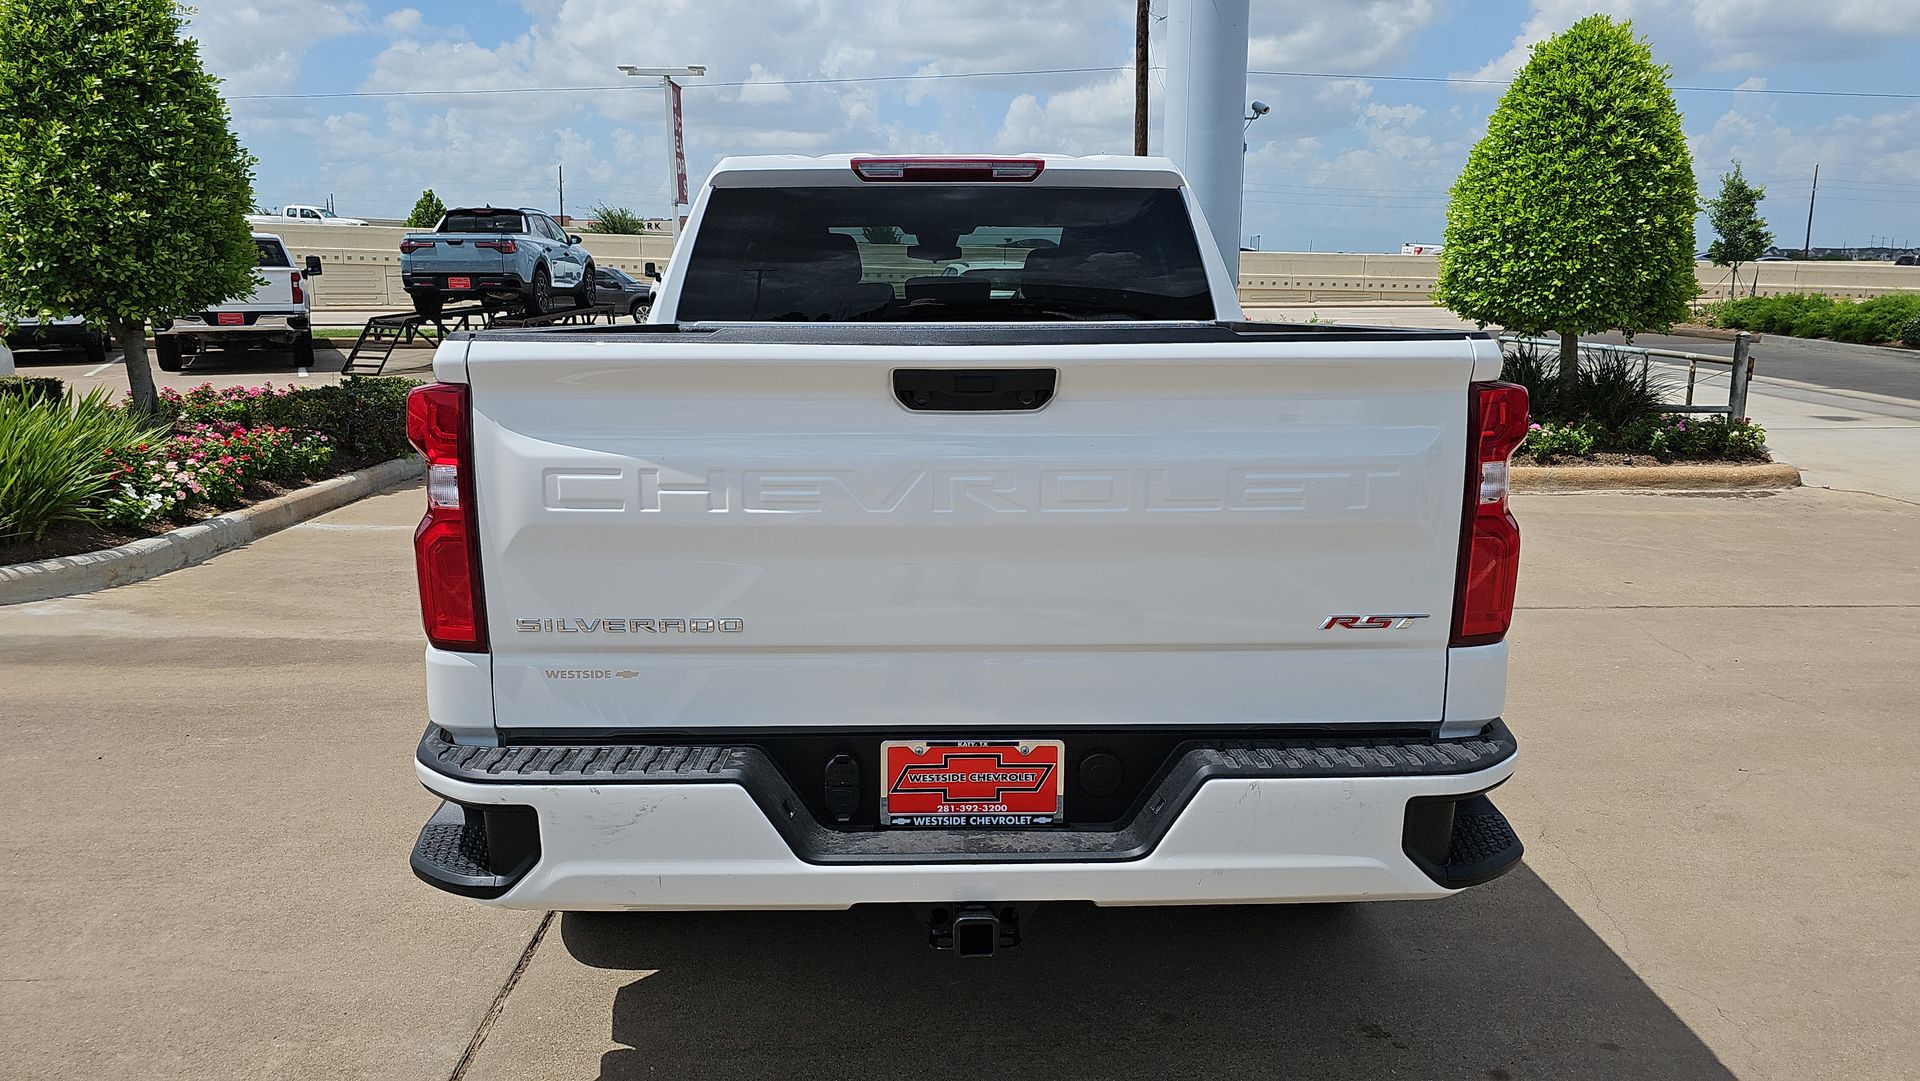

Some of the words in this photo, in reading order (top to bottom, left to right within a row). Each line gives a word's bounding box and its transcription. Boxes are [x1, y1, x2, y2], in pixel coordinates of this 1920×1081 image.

[541, 467, 1402, 514] CHEVROLET
[515, 617, 745, 634] SILVERADO
[1317, 613, 1431, 631] RST
[545, 669, 612, 680] WESTSIDE
[908, 773, 966, 783] WESTSIDE
[969, 772, 1037, 782] CHEVROLET
[936, 804, 1008, 813] 281-392-3200
[913, 816, 967, 826] WESTSIDE
[969, 816, 1032, 825] CHEVROLET
